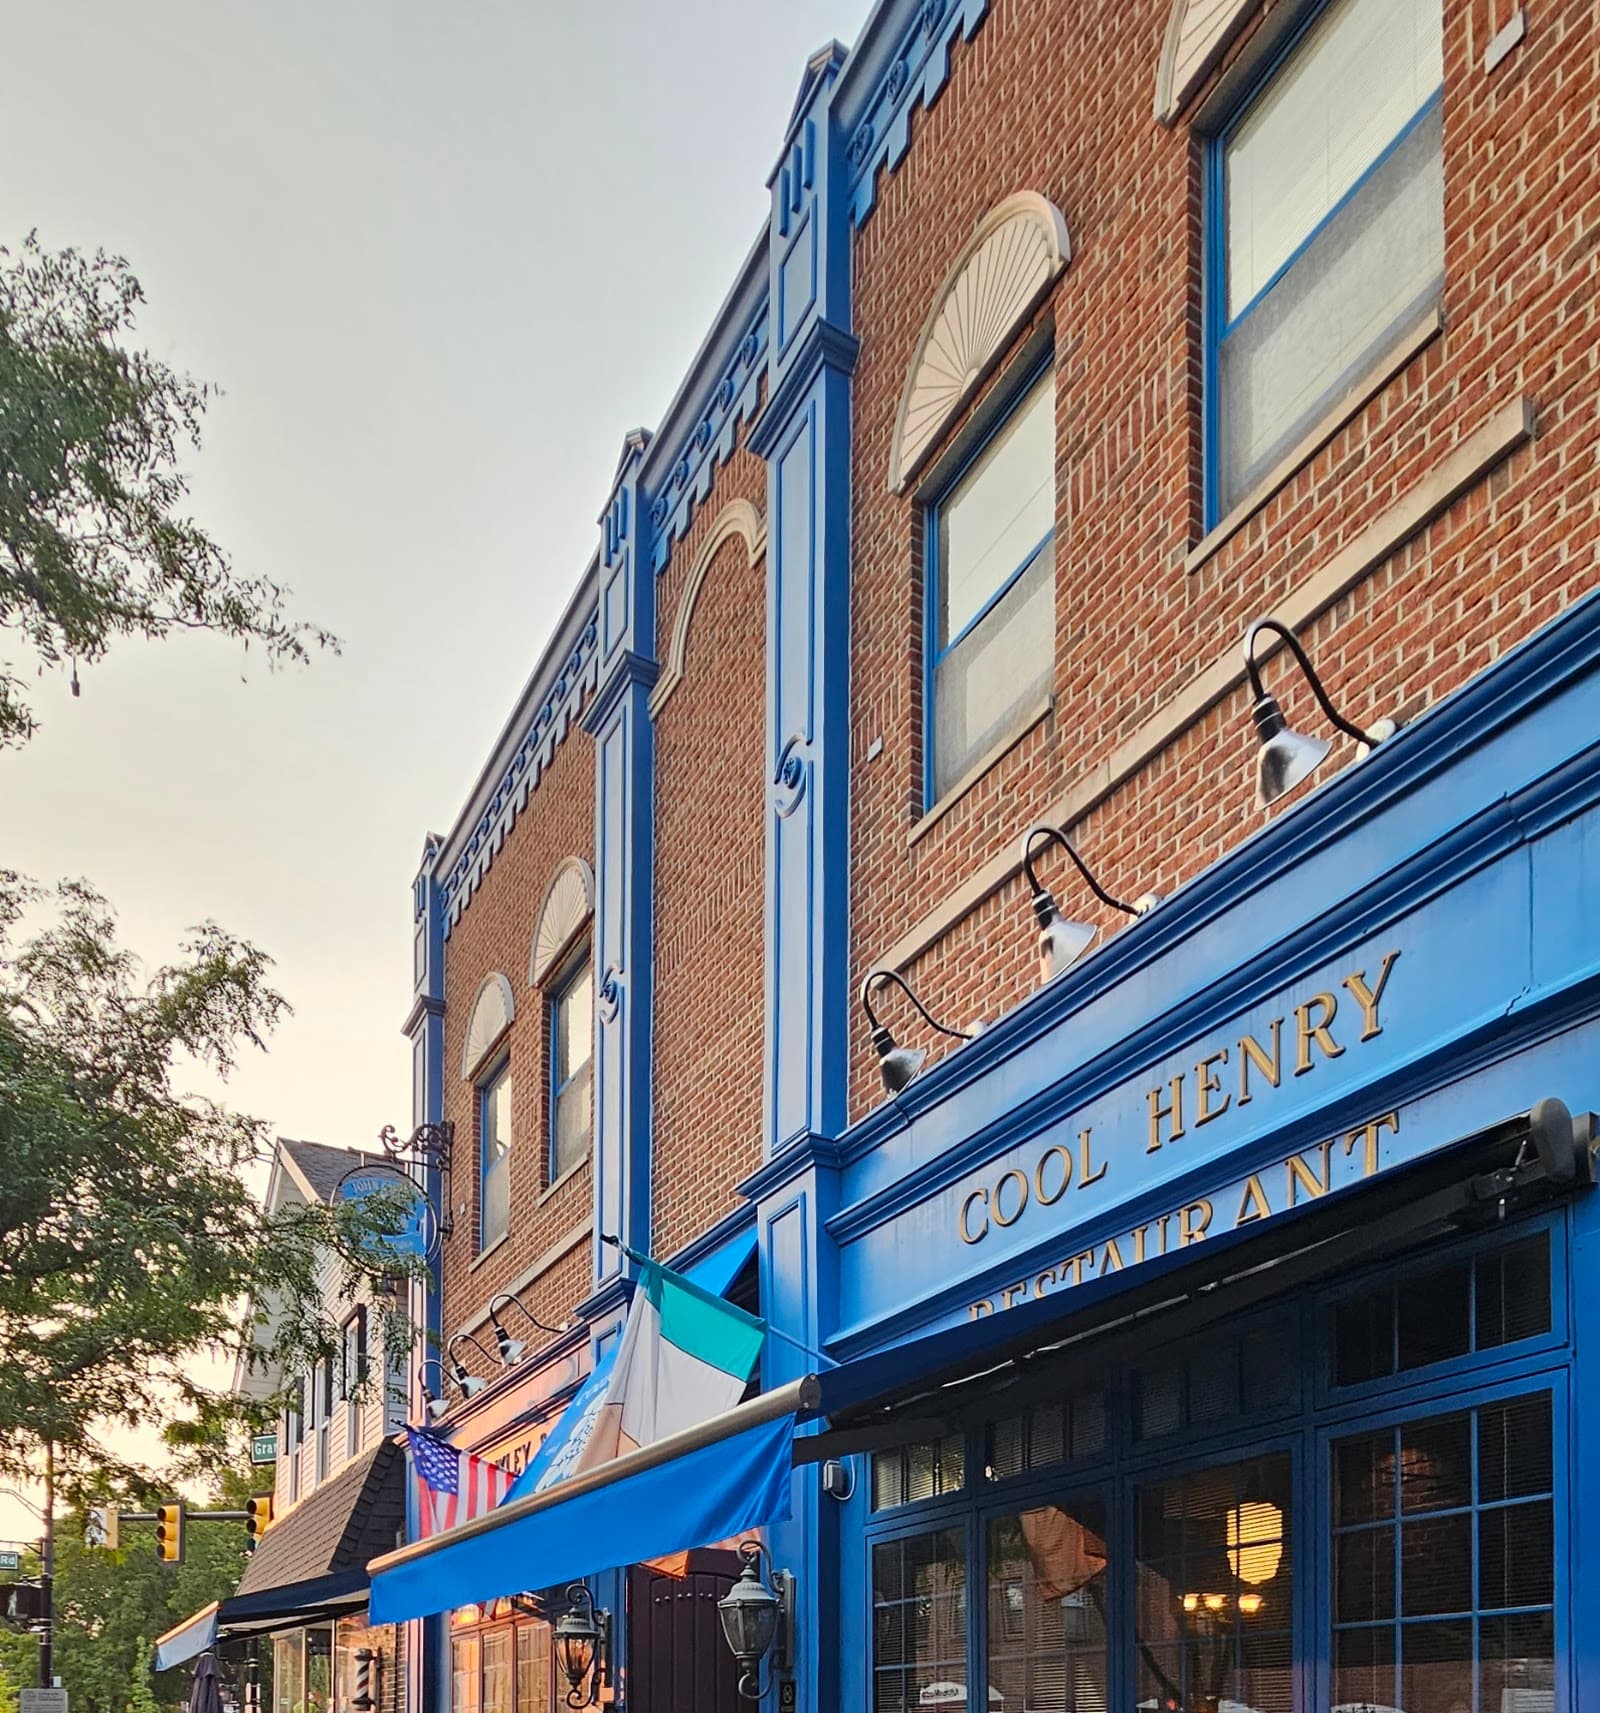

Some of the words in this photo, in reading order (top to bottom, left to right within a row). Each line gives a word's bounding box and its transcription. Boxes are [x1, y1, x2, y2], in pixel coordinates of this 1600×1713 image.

[959, 1127, 1108, 1245] COOL
[1146, 950, 1401, 1154] HENRY
[0, 1555, 15, 1565] Rd
